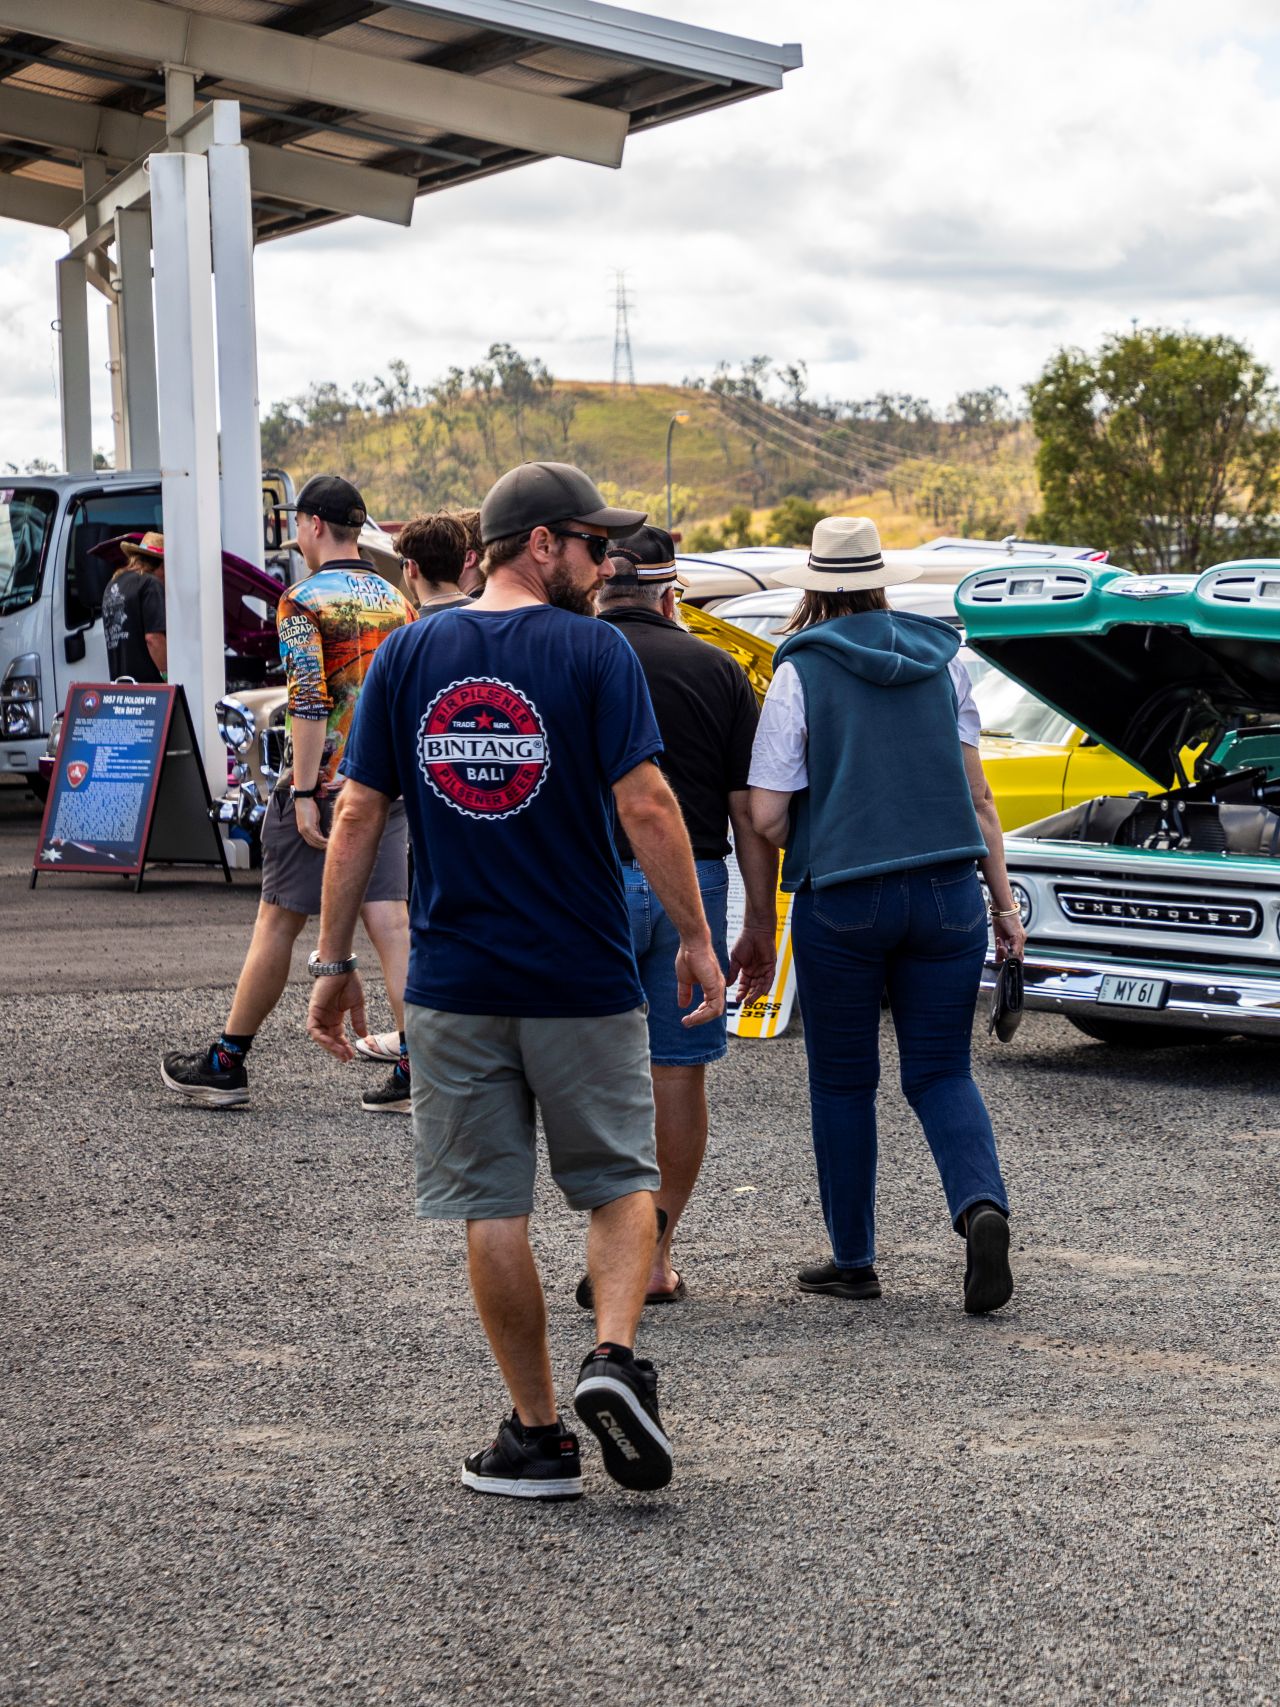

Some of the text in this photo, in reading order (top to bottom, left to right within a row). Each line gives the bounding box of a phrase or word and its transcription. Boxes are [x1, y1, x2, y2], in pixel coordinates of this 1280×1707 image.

[347, 575, 387, 594] CAPE
[291, 614, 308, 625] OLD
[279, 623, 319, 641] TELEGRAPH
[285, 634, 310, 649] TRACK
[435, 688, 530, 725] BIR PILSENER
[452, 720, 476, 728] TRADE
[466, 767, 505, 781] BALI
[439, 768, 535, 806] PILSENER BEER
[1074, 902, 1241, 923] CHEVROLET
[1113, 980, 1137, 1001] MY
[740, 1010, 777, 1018] 351
